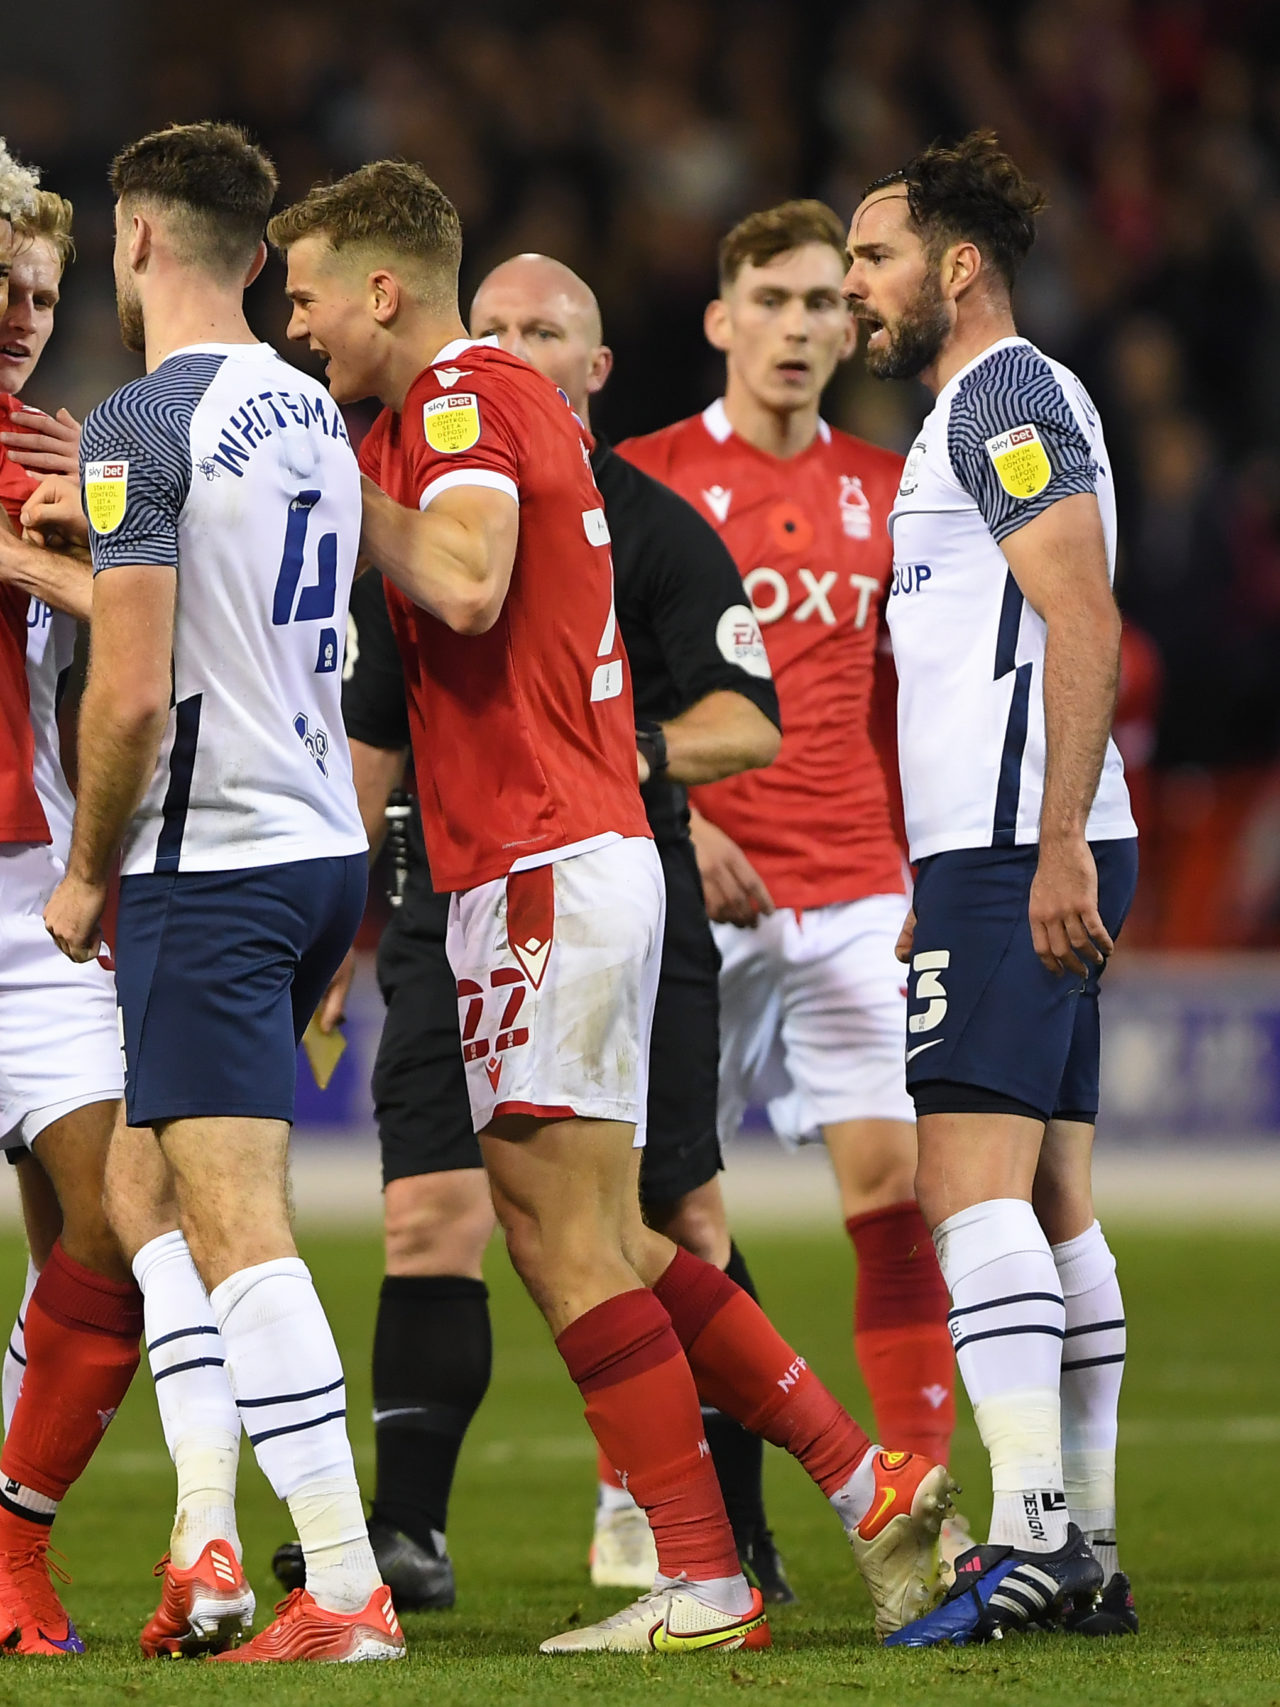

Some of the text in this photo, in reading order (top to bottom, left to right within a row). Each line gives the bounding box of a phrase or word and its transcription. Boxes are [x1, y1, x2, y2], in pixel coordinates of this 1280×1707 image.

[427, 397, 471, 412] sky bet
[991, 429, 1032, 452] sky bet
[88, 466, 123, 478] sky bet
[272, 489, 338, 673] 4
[892, 564, 932, 597] OUP
[743, 567, 879, 628] OXT
[457, 967, 529, 1063] 22
